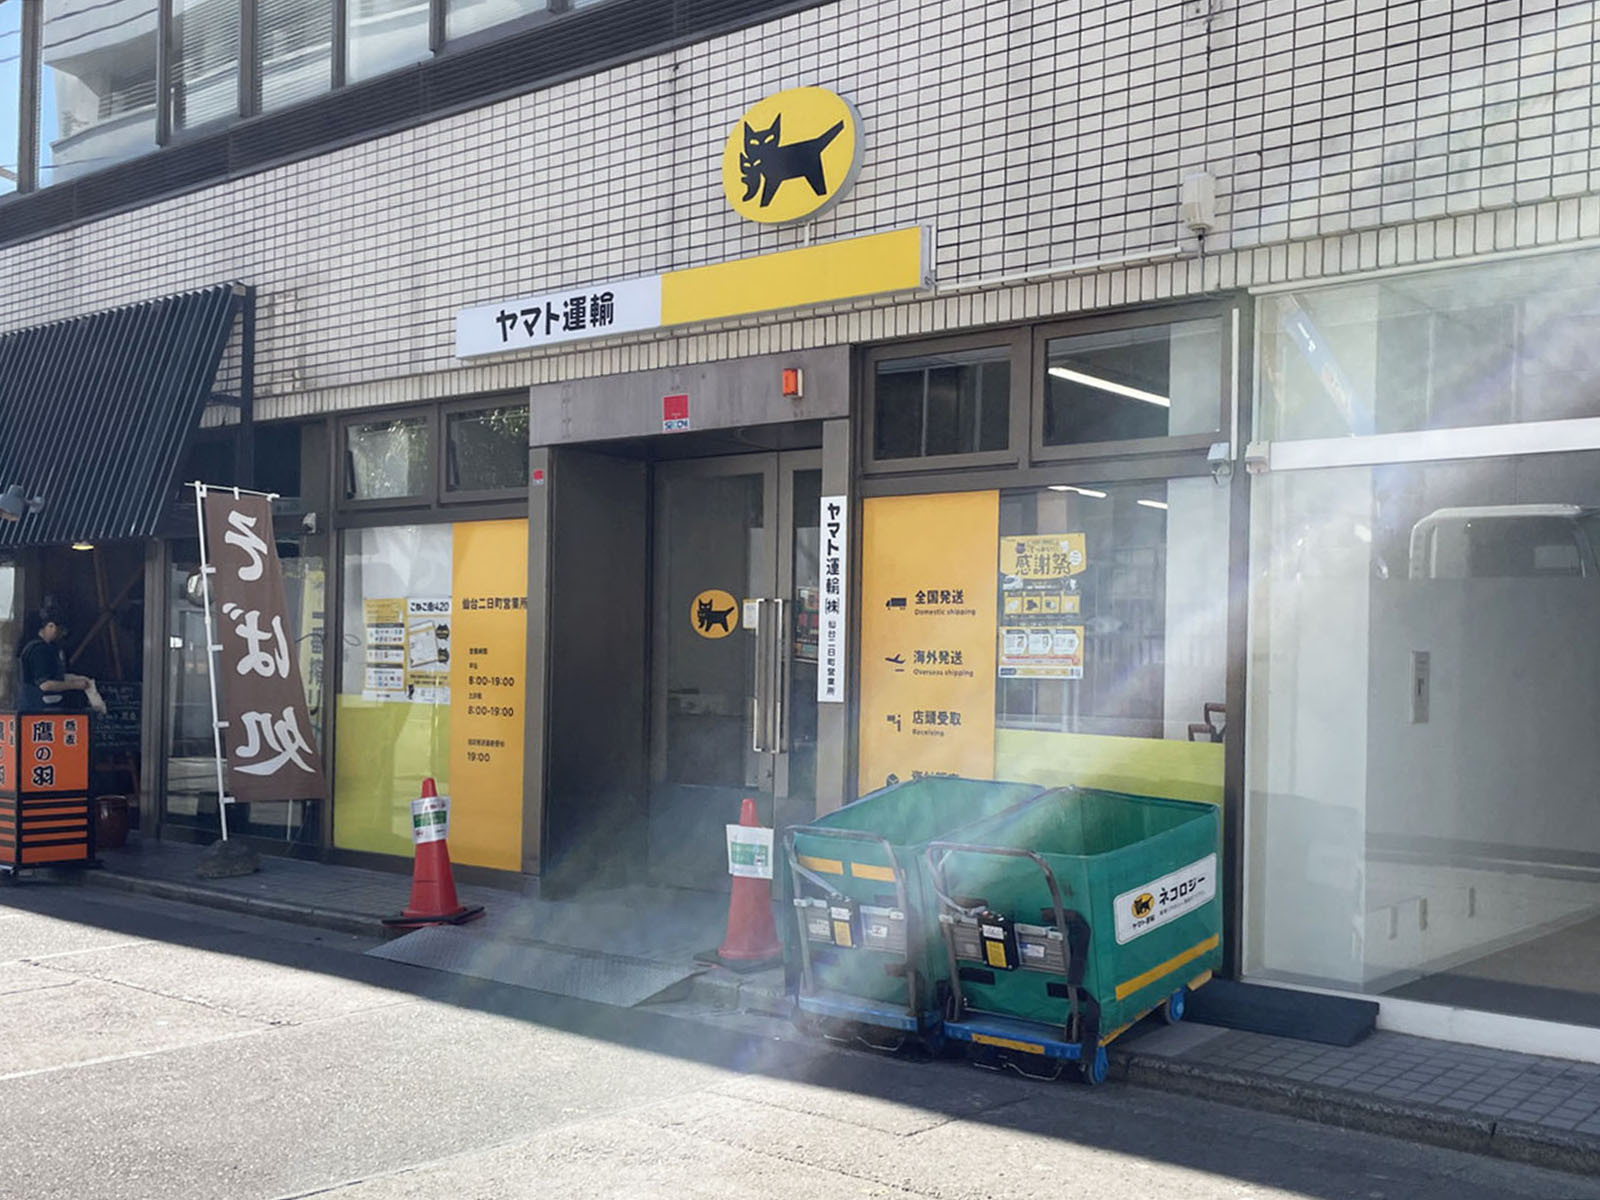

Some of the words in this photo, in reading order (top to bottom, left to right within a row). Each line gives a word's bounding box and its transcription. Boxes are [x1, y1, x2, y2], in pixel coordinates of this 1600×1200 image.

[496, 291, 614, 342] ヤマト運輸
[1015, 553, 1071, 575] 感謝祭
[463, 597, 527, 611] 仙台二日町営業所
[915, 590, 964, 605] 全国発送
[914, 608, 945, 616] Domestic
[947, 608, 976, 617] shipping
[913, 651, 963, 666] 海外発送
[945, 669, 974, 678] shipping
[469, 677, 514, 687] 8:00-19:00
[912, 710, 961, 725] 店頭受取
[912, 729, 944, 737] Receiving
[32, 720, 54, 787] 鷹の羽
[467, 752, 490, 763] 19:00
[1160, 878, 1205, 905] ネコロジー
